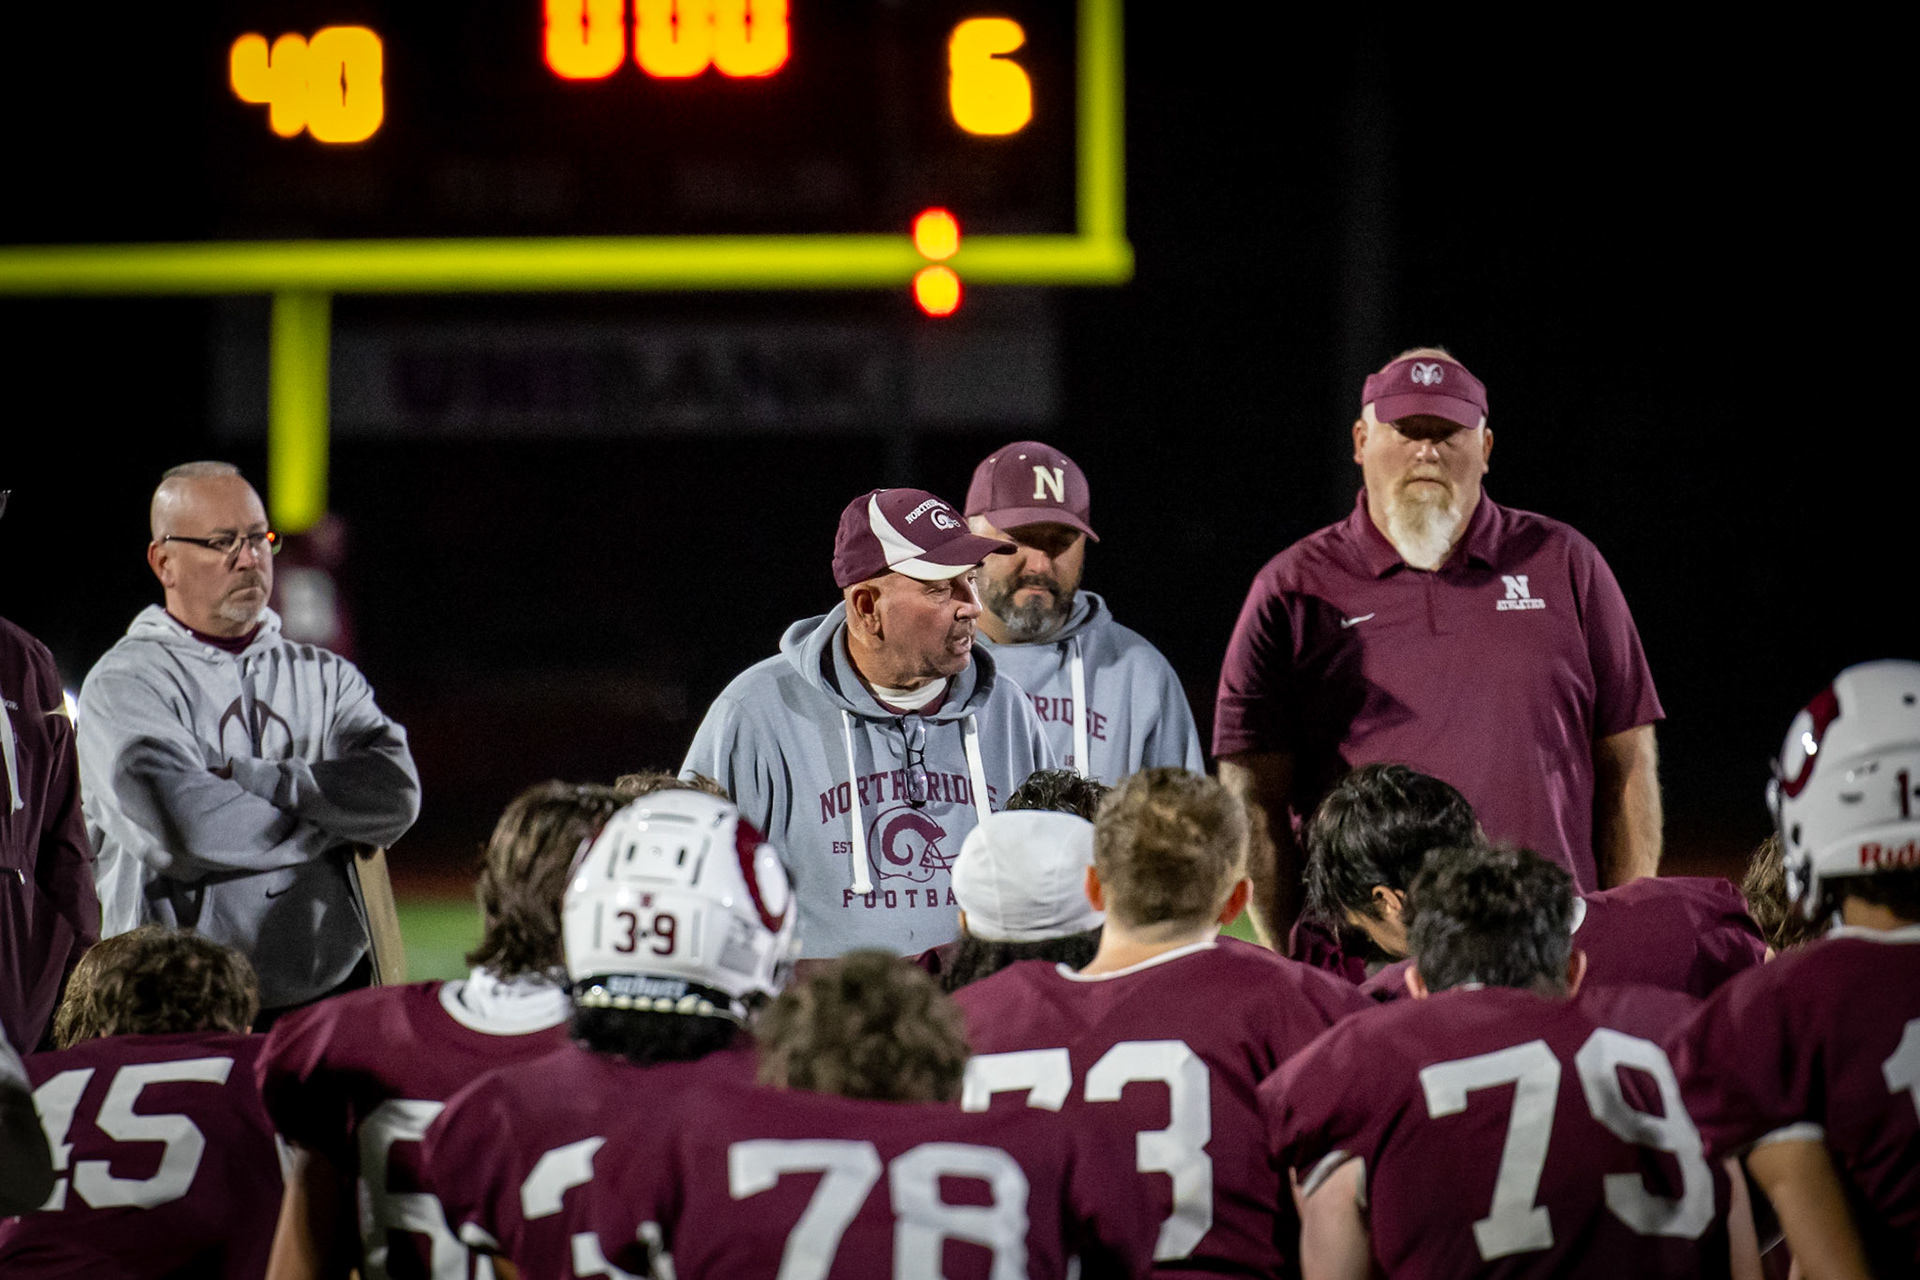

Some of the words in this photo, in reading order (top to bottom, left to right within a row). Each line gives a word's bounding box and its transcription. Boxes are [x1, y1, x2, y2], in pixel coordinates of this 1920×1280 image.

[230, 25, 384, 143] 40
[948, 16, 1033, 136] 6
[1032, 465, 1065, 503] N
[1501, 574, 1531, 600] N
[615, 910, 676, 956] 39
[842, 888, 958, 909] FOOTBA
[1419, 1027, 1716, 1262] 79
[728, 1138, 1031, 1280] 78
